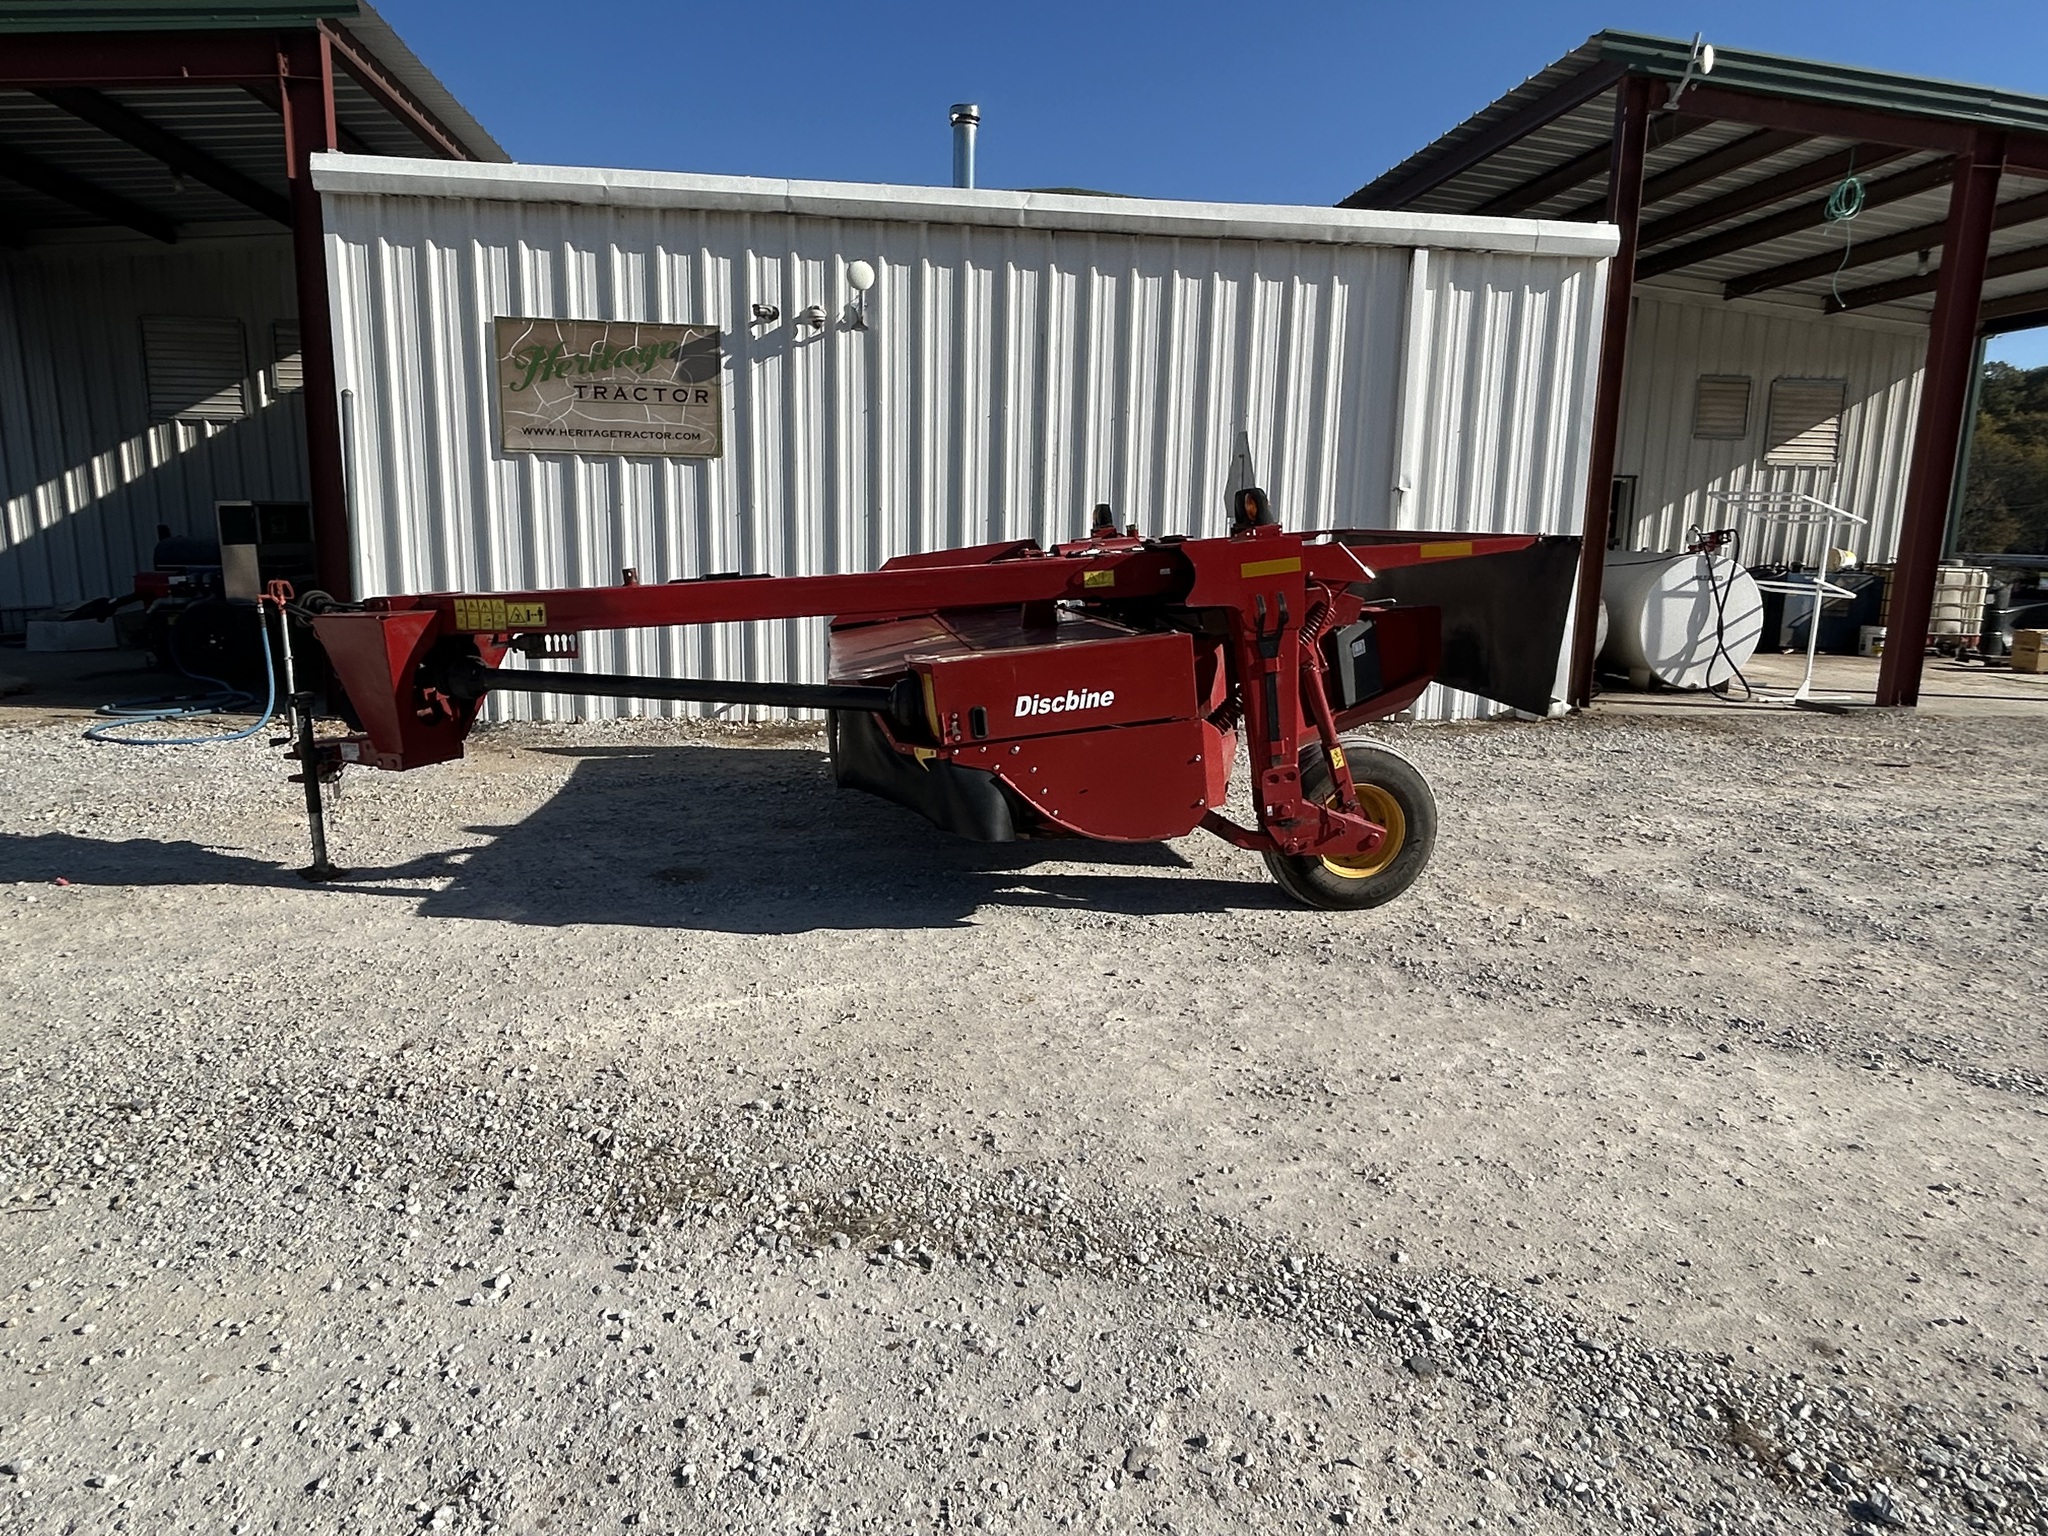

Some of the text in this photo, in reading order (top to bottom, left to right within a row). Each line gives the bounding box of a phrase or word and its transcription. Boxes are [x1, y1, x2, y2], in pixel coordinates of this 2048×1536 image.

[510, 340, 677, 391] Heritage
[574, 384, 709, 403] TRACTOR
[522, 426, 701, 441] WWW.HERITAGETRACTOR.COM
[1014, 687, 1115, 718] Discbine
